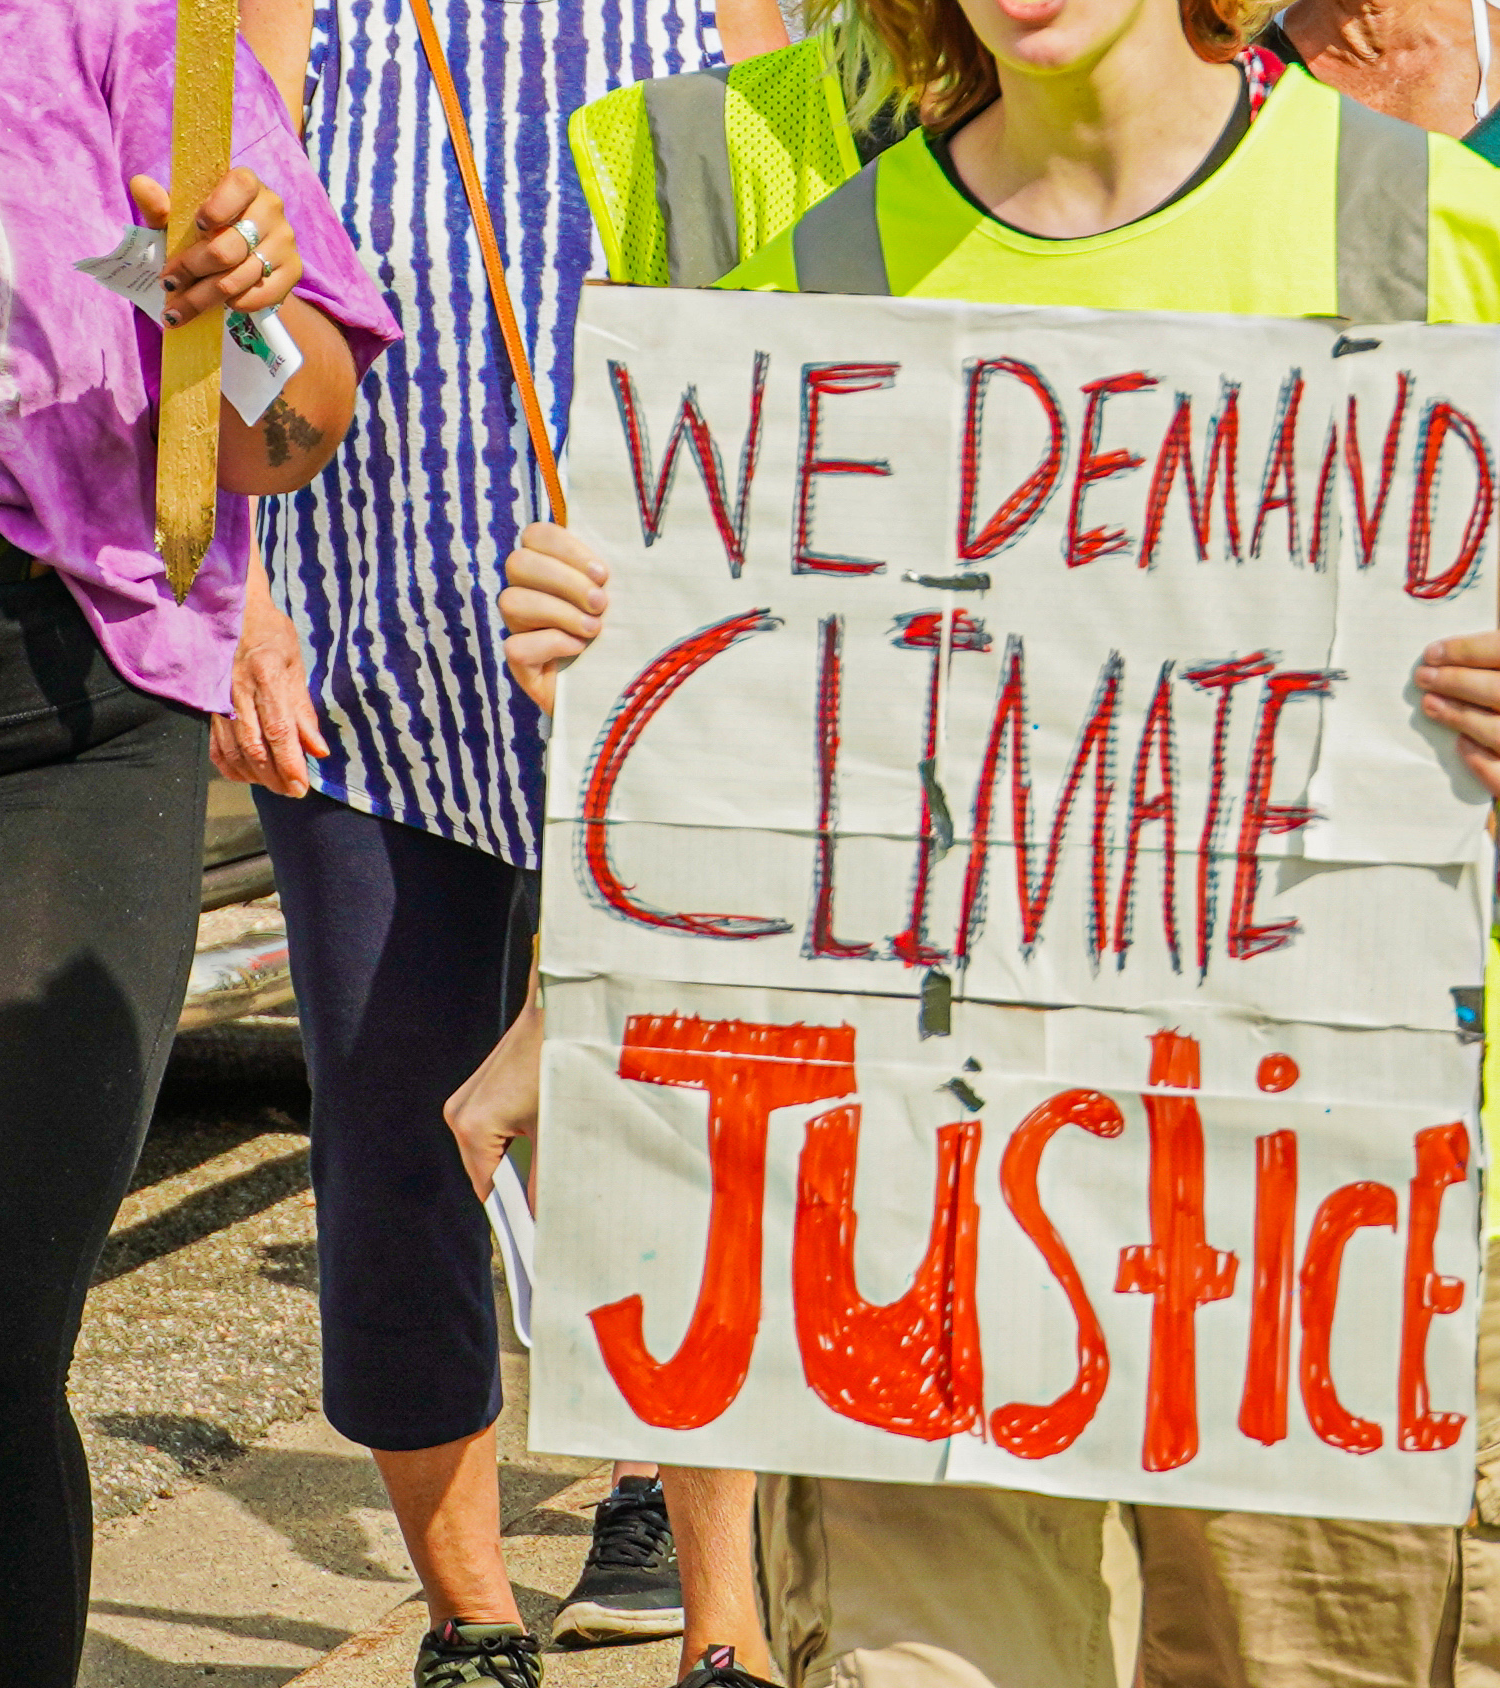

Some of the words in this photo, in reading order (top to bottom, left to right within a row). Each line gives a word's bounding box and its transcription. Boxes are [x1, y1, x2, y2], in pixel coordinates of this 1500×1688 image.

[607, 350, 903, 578] WE
[955, 355, 1496, 601] DEMAND
[575, 607, 1348, 987] CLIMATE
